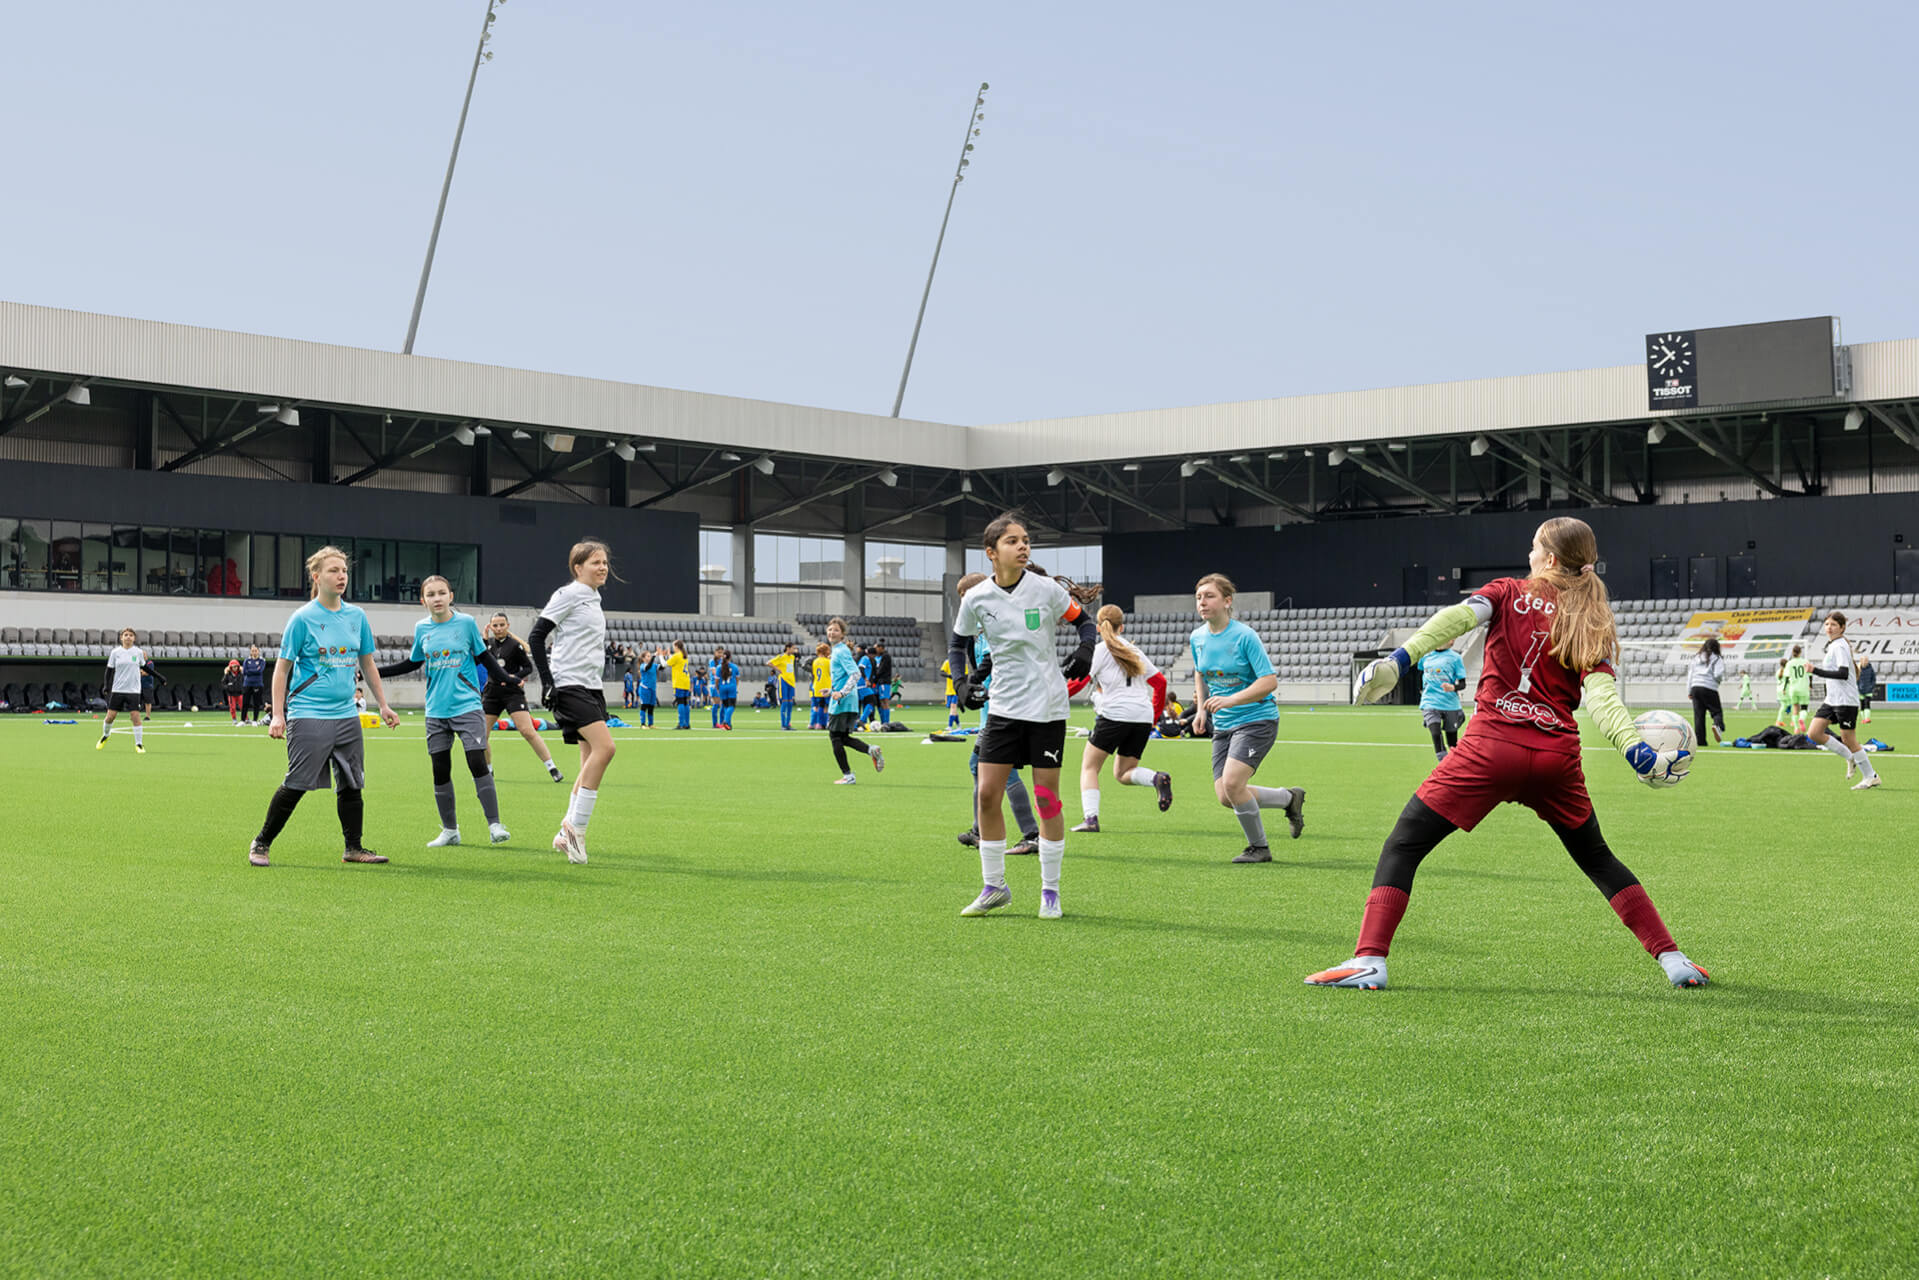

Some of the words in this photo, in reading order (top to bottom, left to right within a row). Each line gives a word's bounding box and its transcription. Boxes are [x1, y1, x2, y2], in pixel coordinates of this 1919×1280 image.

[1652, 386, 1692, 396] TISSOT
[1845, 616, 1919, 627] ALAC
[1824, 640, 1894, 654] CIL
[816, 667, 822, 681] 9
[1792, 664, 1805, 679] 10
